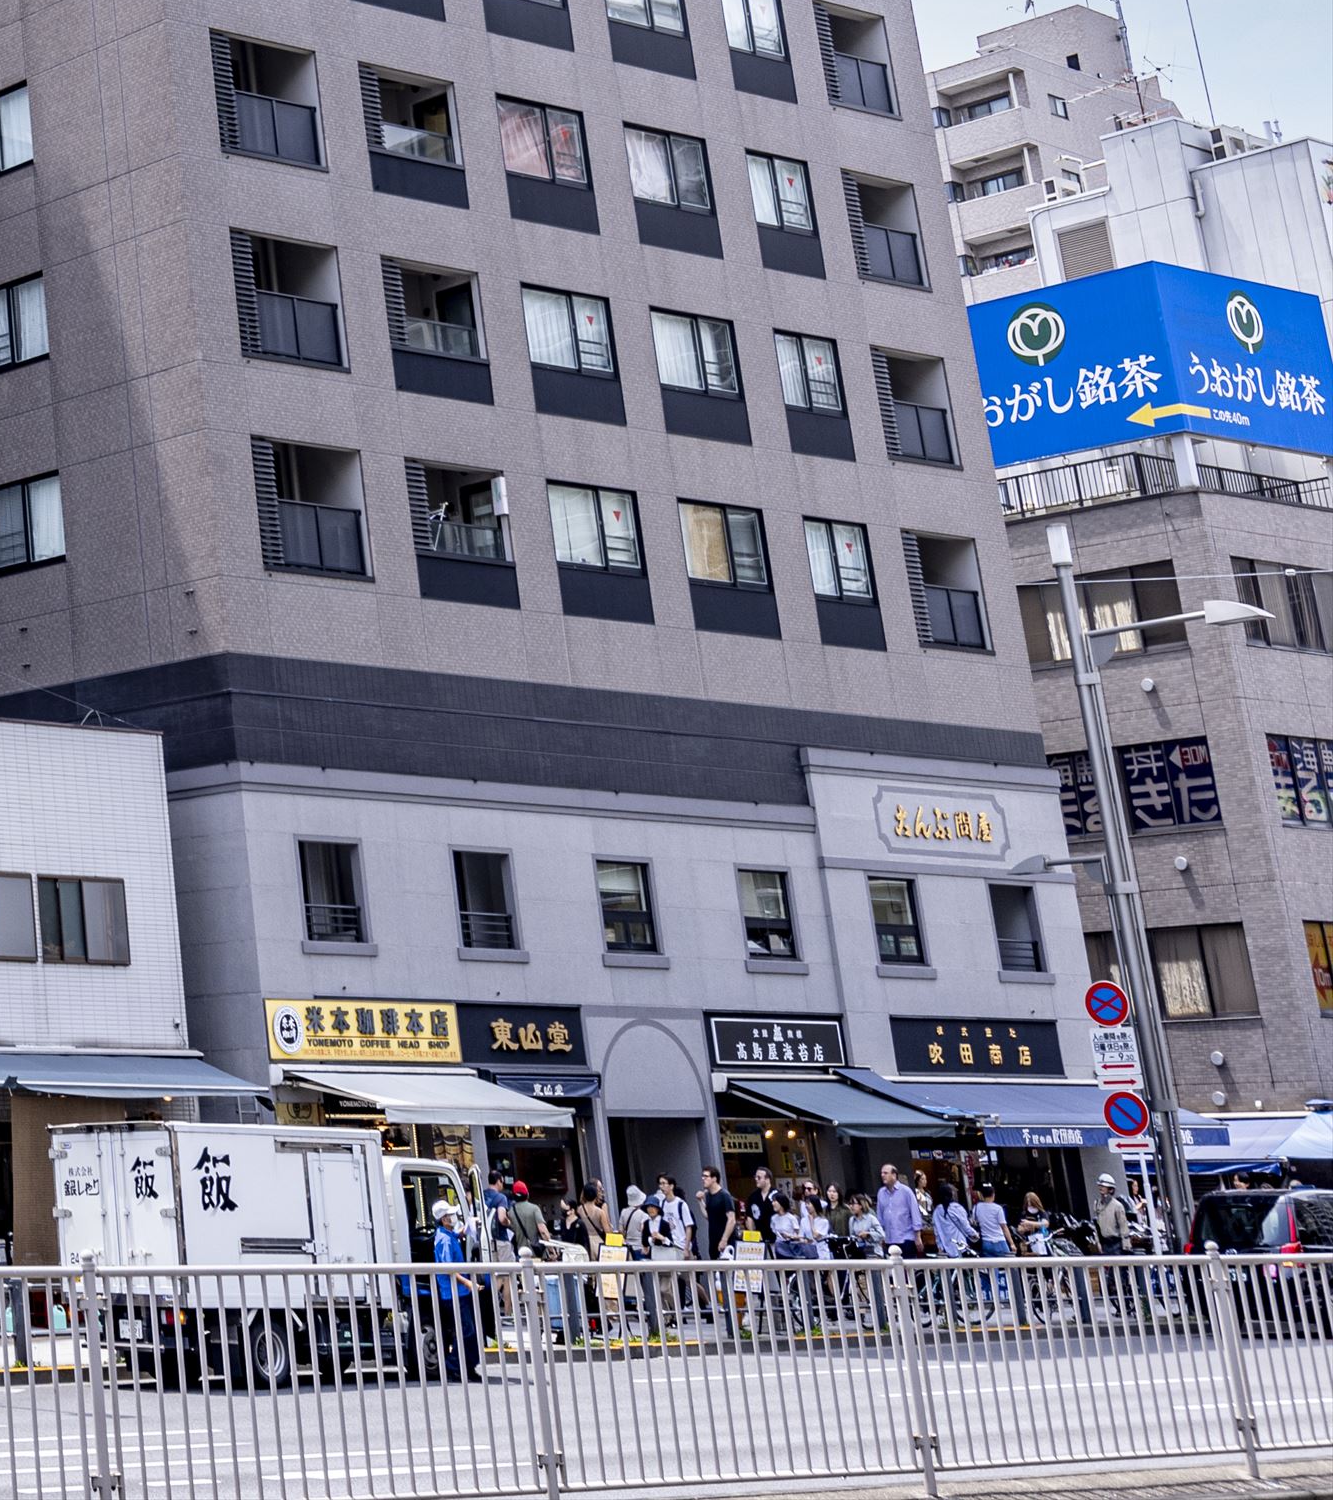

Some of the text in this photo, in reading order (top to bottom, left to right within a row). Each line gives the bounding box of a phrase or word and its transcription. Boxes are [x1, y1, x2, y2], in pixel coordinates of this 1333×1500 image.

[1188, 351, 1326, 415] うおがし銘茶
[305, 1006, 450, 1037] 米本珈琲本店
[490, 1018, 573, 1052] 東山堂
[307, 1038, 450, 1050] YONEMOTO COFFEE HEAD SHOP
[928, 1042, 1032, 1066] 吹田商店
[532, 1083, 565, 1097] 東山堂
[68, 1166, 94, 1177] 株式会社
[130, 1156, 159, 1199] 飯
[193, 1147, 239, 1212] 飯
